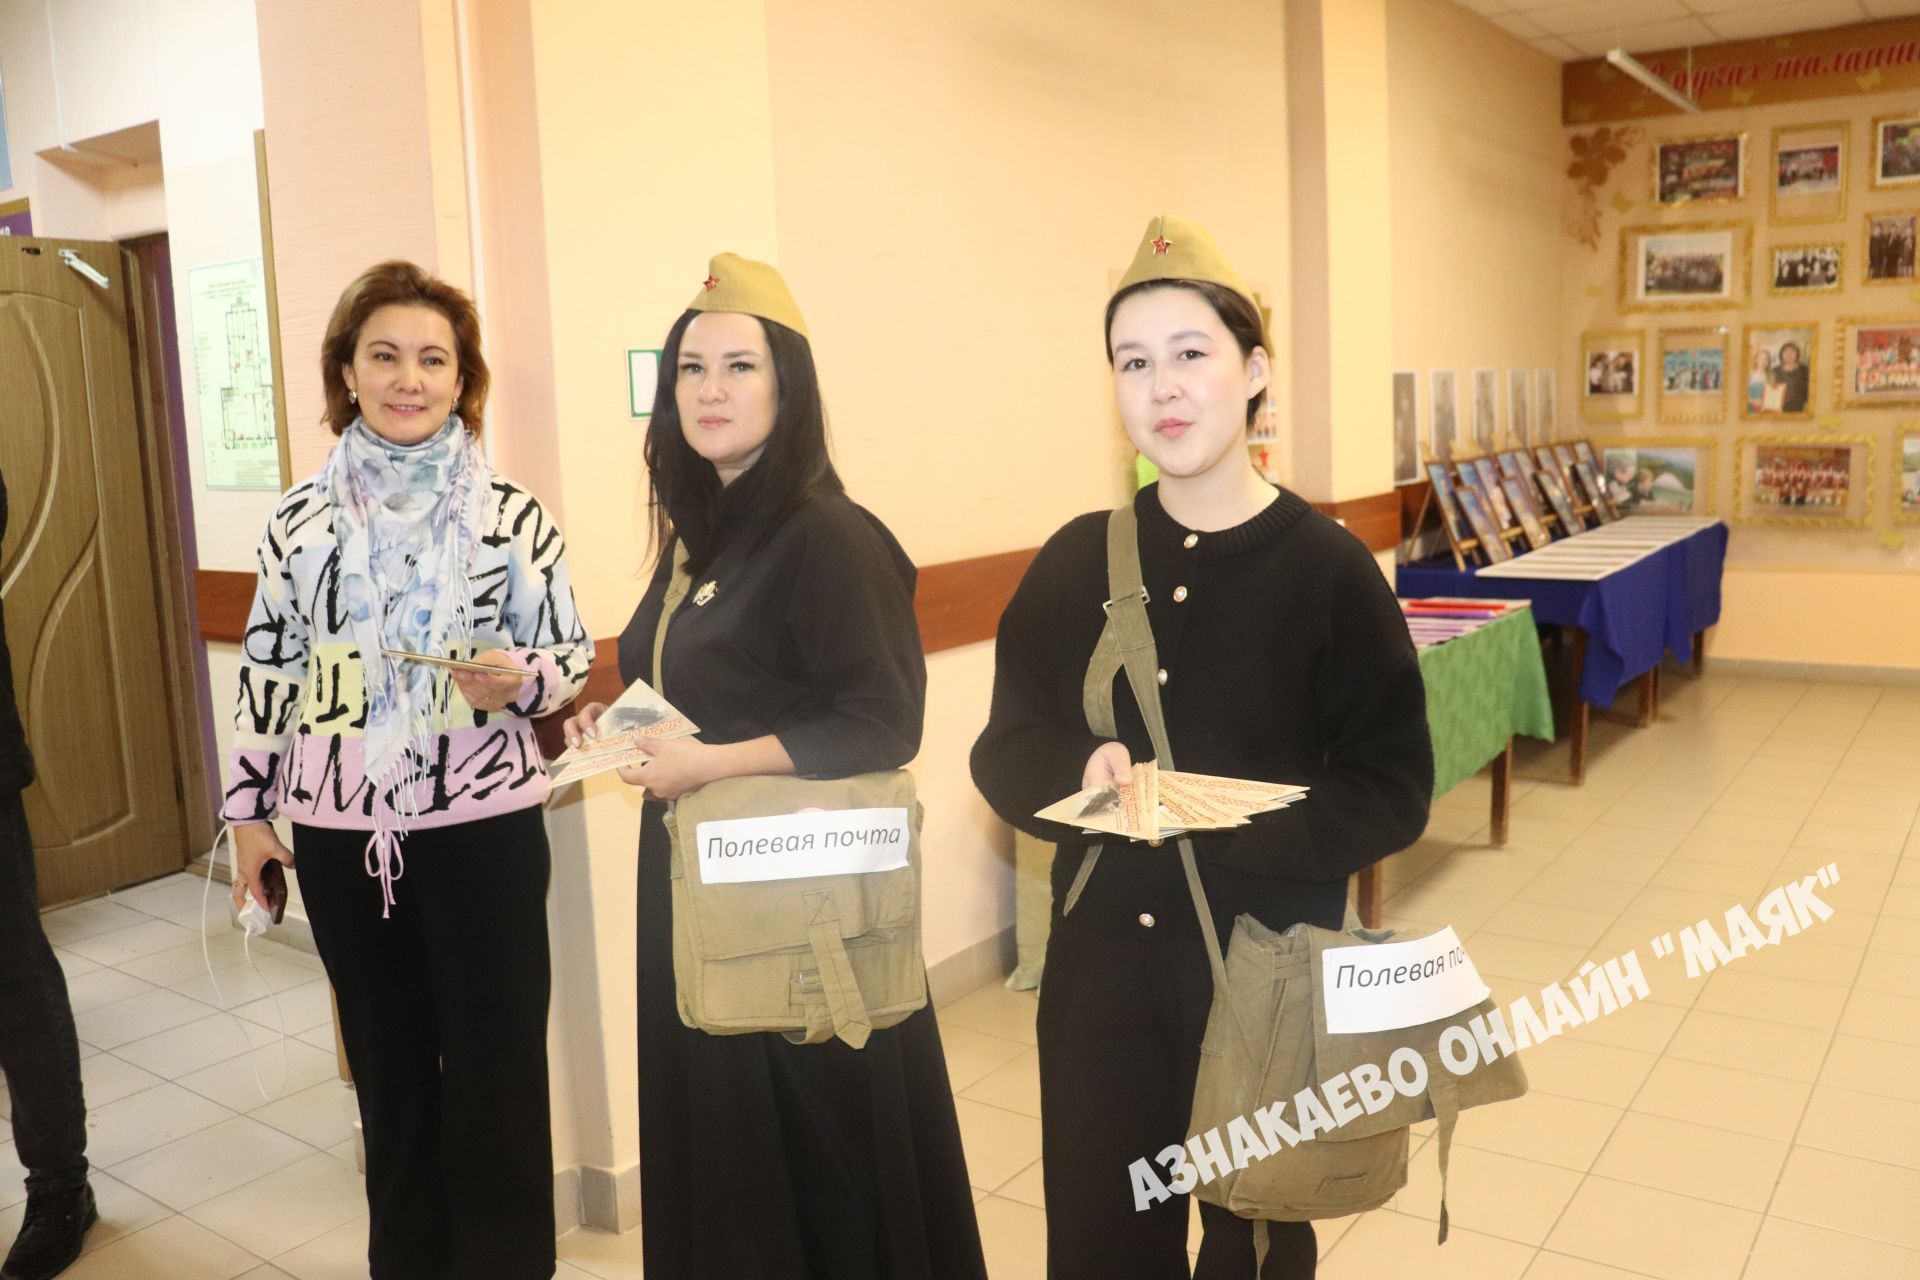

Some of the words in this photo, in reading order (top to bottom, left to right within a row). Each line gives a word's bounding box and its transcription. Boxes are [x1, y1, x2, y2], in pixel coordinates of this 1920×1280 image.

[708, 833, 815, 859] Полевая
[824, 827, 901, 849] почта
[1336, 956, 1445, 989] Полевая
[1448, 946, 1465, 970] по
